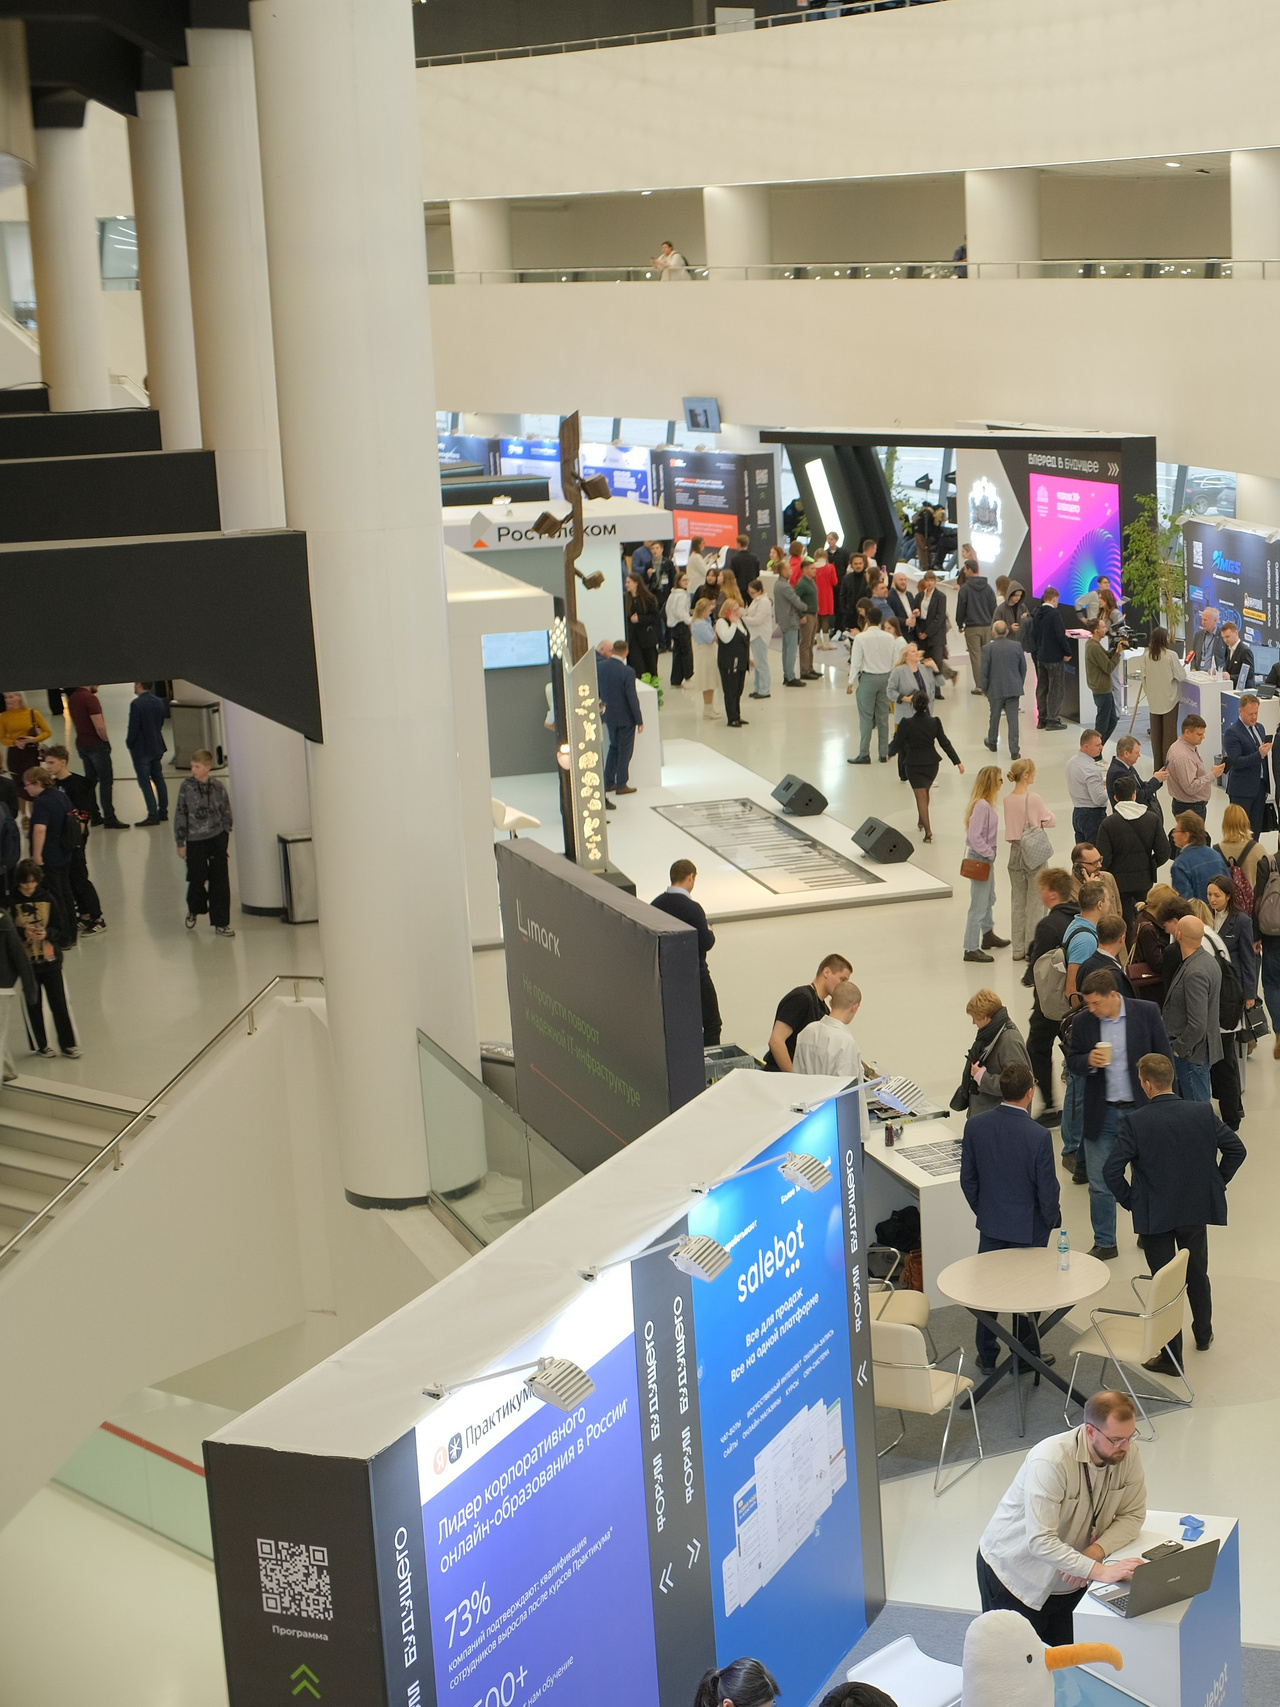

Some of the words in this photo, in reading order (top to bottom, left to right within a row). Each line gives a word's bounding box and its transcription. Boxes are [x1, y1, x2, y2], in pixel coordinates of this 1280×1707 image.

[516, 898, 561, 958] Limark
[522, 972, 533, 995] Не
[533, 982, 568, 1021] пропусти
[567, 1006, 600, 1045] поворот
[530, 1010, 567, 1047] надежной
[737, 1219, 805, 1303] salebot
[745, 1329, 760, 1347] Все
[760, 1314, 775, 1334] для
[775, 1286, 804, 1320] продаж
[852, 1265, 862, 1333] ФОРУМ
[730, 1361, 745, 1383] Все
[746, 1352, 756, 1369] на
[756, 1328, 779, 1358] одной
[779, 1293, 819, 1337] платформе
[465, 1383, 535, 1448] Практикум
[785, 1378, 800, 1396] КУРСЫ
[438, 1495, 482, 1545] Лидер
[485, 1407, 586, 1504] корпоративного
[652, 1452, 666, 1533] ФОРУМ
[681, 1425, 694, 1504] ФОРУМ
[440, 1445, 575, 1574] онлайн-образования
[577, 1438, 584, 1455] в
[271, 1624, 329, 1641] Программа
[444, 1580, 491, 1649] 73%
[448, 1630, 486, 1673] компаний
[486, 1581, 540, 1638] подтверждают:
[539, 1536, 588, 1587] квалификация
[449, 1641, 497, 1690] сотрудников
[497, 1610, 528, 1645] выросла
[528, 1589, 548, 1615] после
[548, 1568, 572, 1596] курсов
[473, 1664, 528, 1707] 00+
[542, 1655, 574, 1692] обучение
